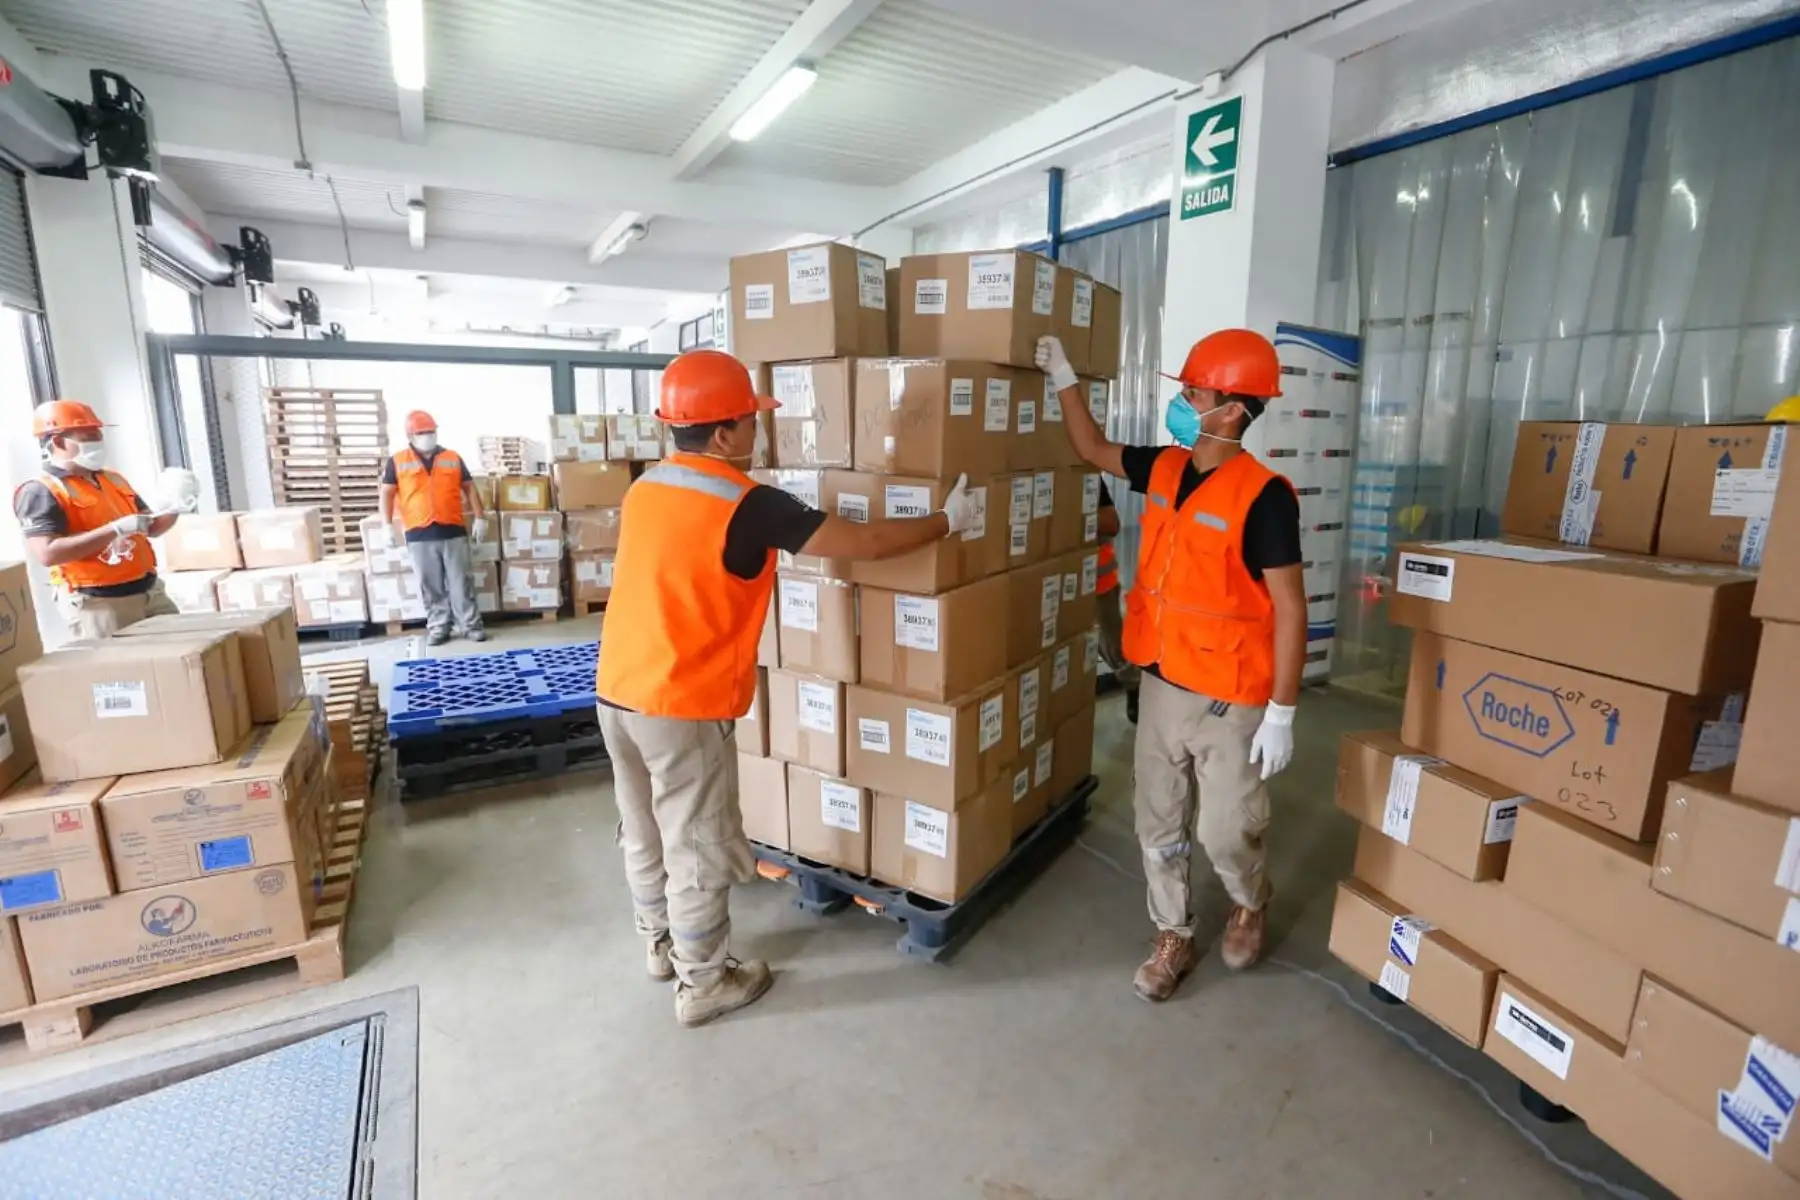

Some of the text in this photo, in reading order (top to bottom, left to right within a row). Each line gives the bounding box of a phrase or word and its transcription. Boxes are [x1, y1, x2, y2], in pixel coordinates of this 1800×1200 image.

[1184, 183, 1229, 211] SALIDA
[894, 504, 918, 516] 38937
[1552, 686, 1586, 705] LOT
[1481, 691, 1550, 738] Roche
[1571, 761, 1607, 784] Lot
[1558, 787, 1617, 821] 023
[70, 956, 134, 977] LABORATORIO
[136, 953, 148, 963] DE
[150, 943, 203, 959] PRODUCTOS
